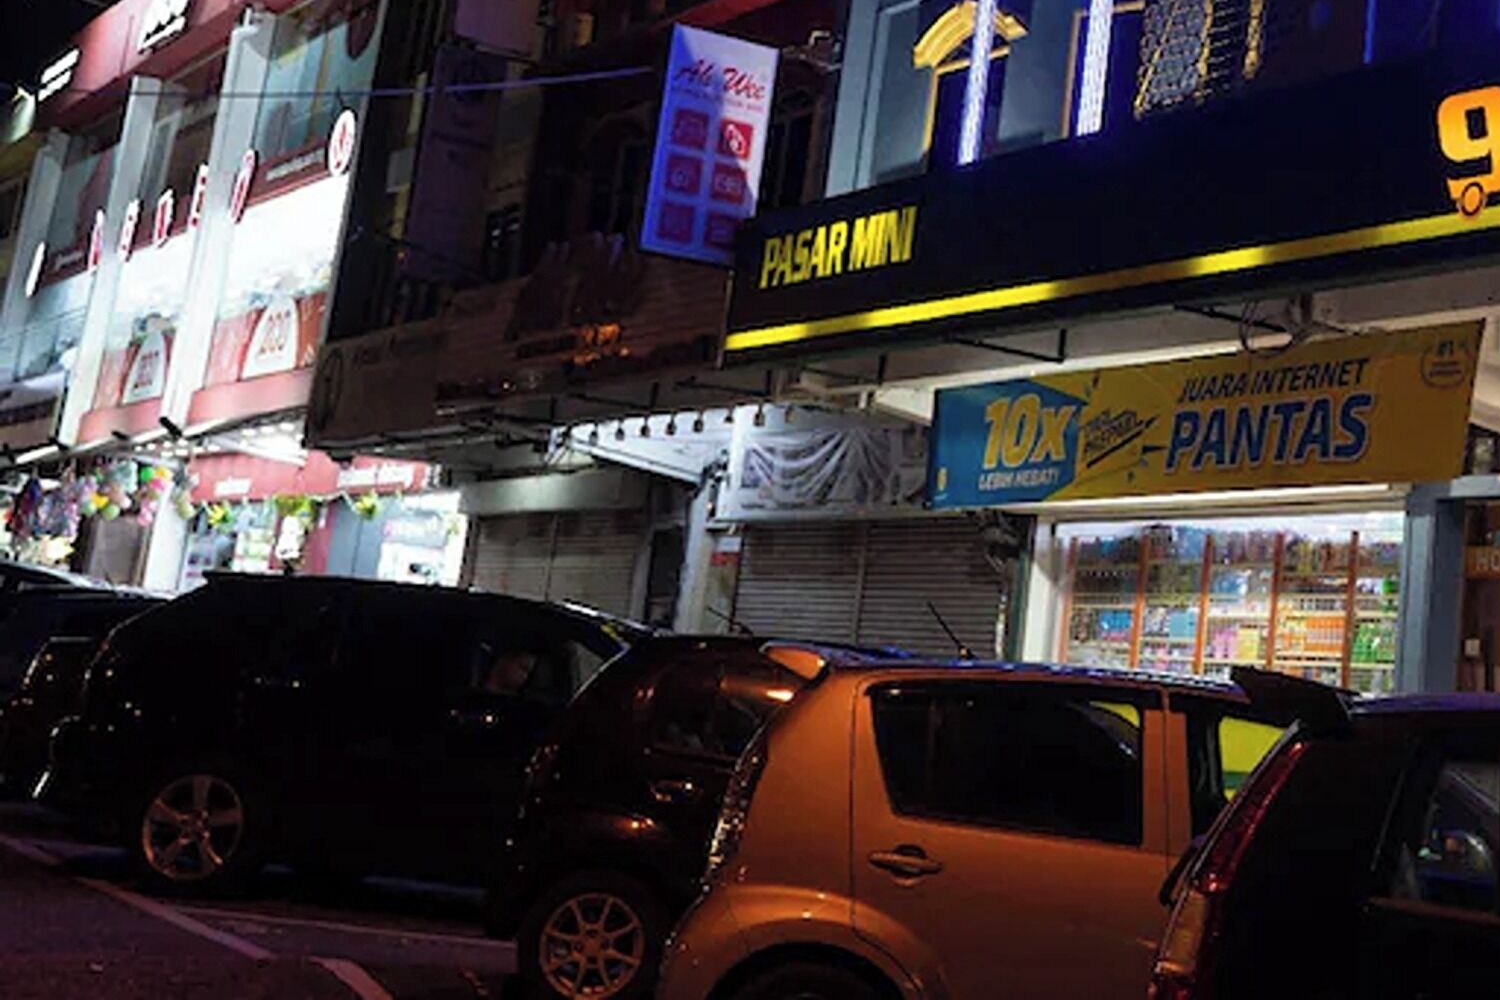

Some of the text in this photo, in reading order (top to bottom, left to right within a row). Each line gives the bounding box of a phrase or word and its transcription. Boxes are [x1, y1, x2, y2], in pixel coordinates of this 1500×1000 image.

[759, 205, 918, 290] PASAR MINI
[1176, 356, 1371, 404] JUARA INTERNET
[1165, 391, 1375, 475] PANTAS
